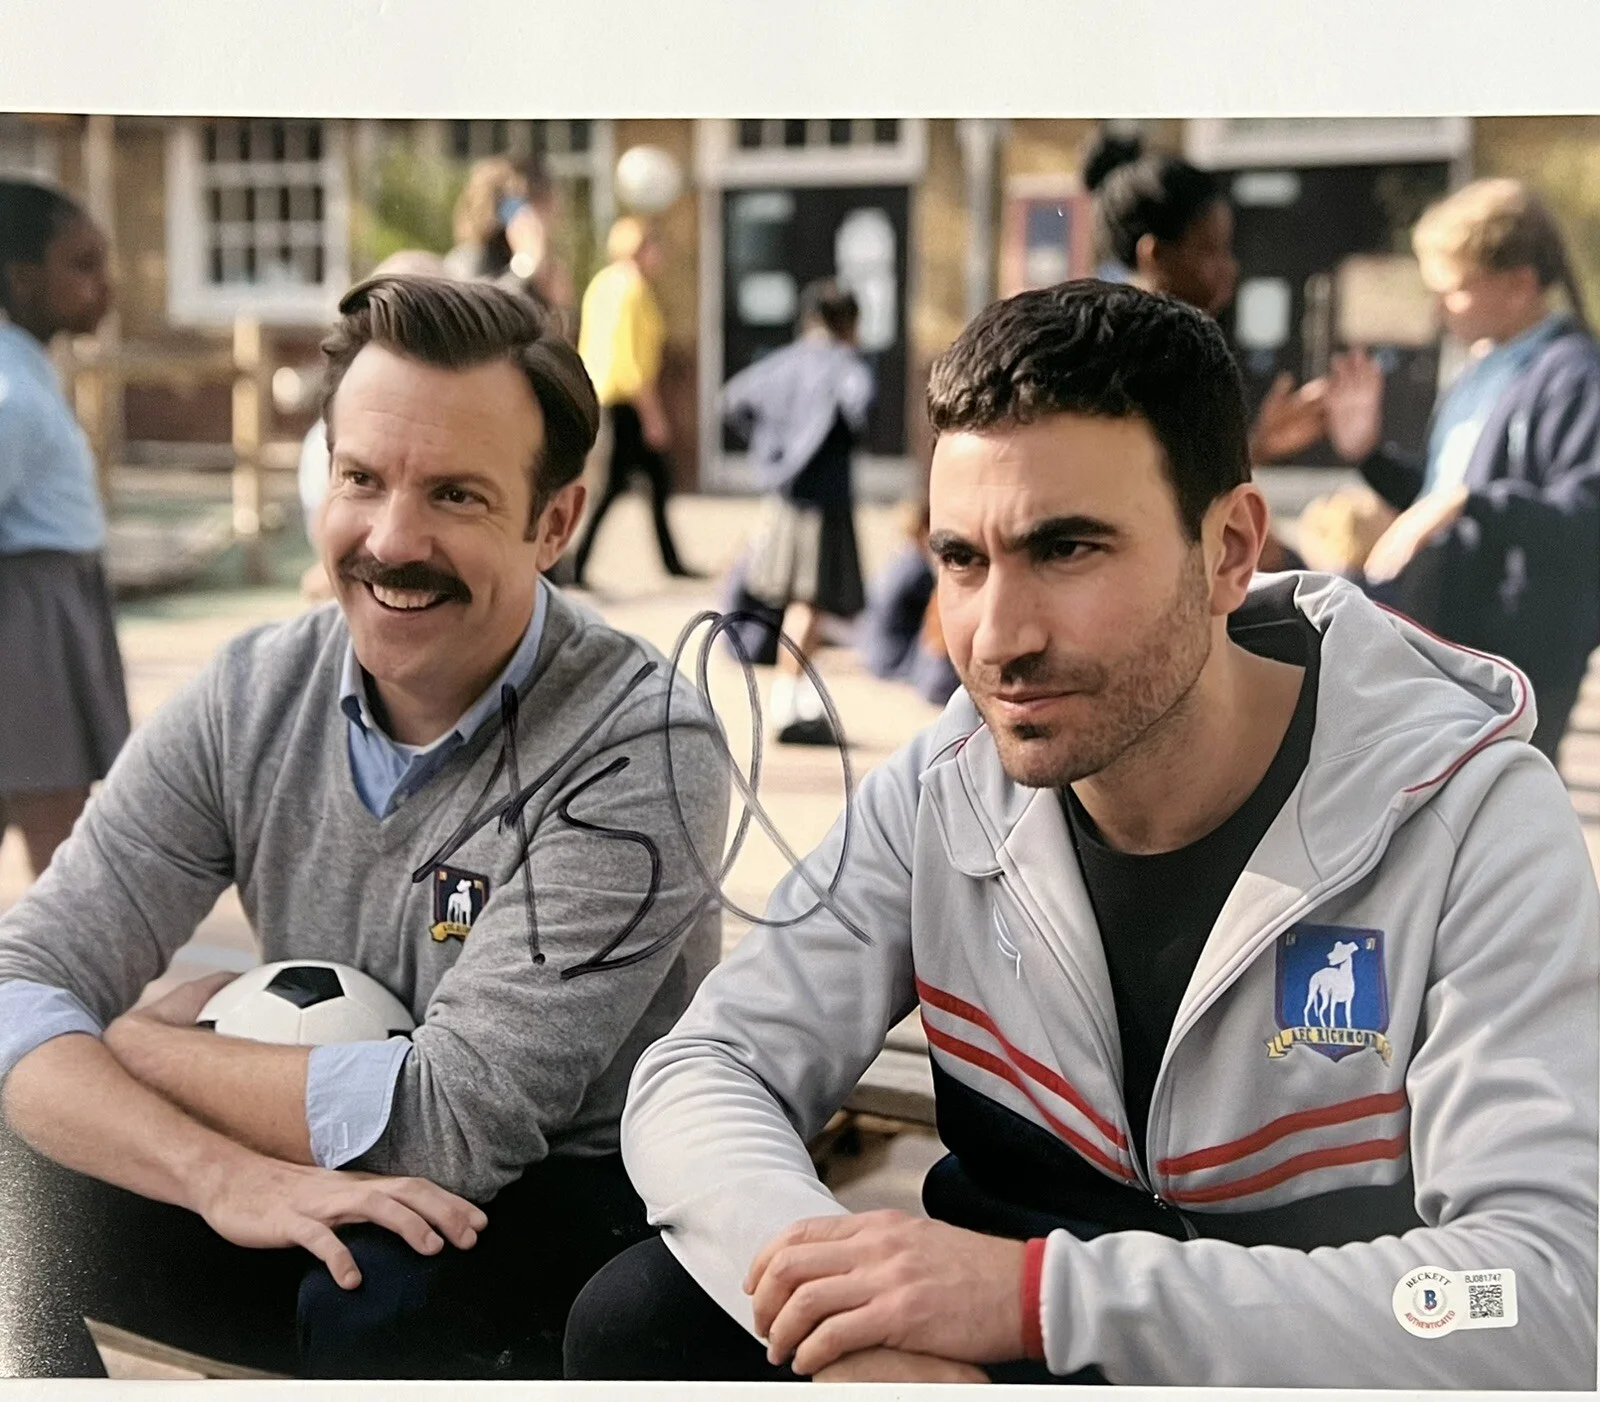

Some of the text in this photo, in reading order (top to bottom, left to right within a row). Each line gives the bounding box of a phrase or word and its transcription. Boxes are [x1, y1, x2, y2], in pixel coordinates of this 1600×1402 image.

[1405, 1272, 1452, 1288] BECKETT
[1465, 1273, 1502, 1284] BJ081747
[1424, 1289, 1438, 1310] B
[1404, 1310, 1456, 1329] AUTHENTICATED
